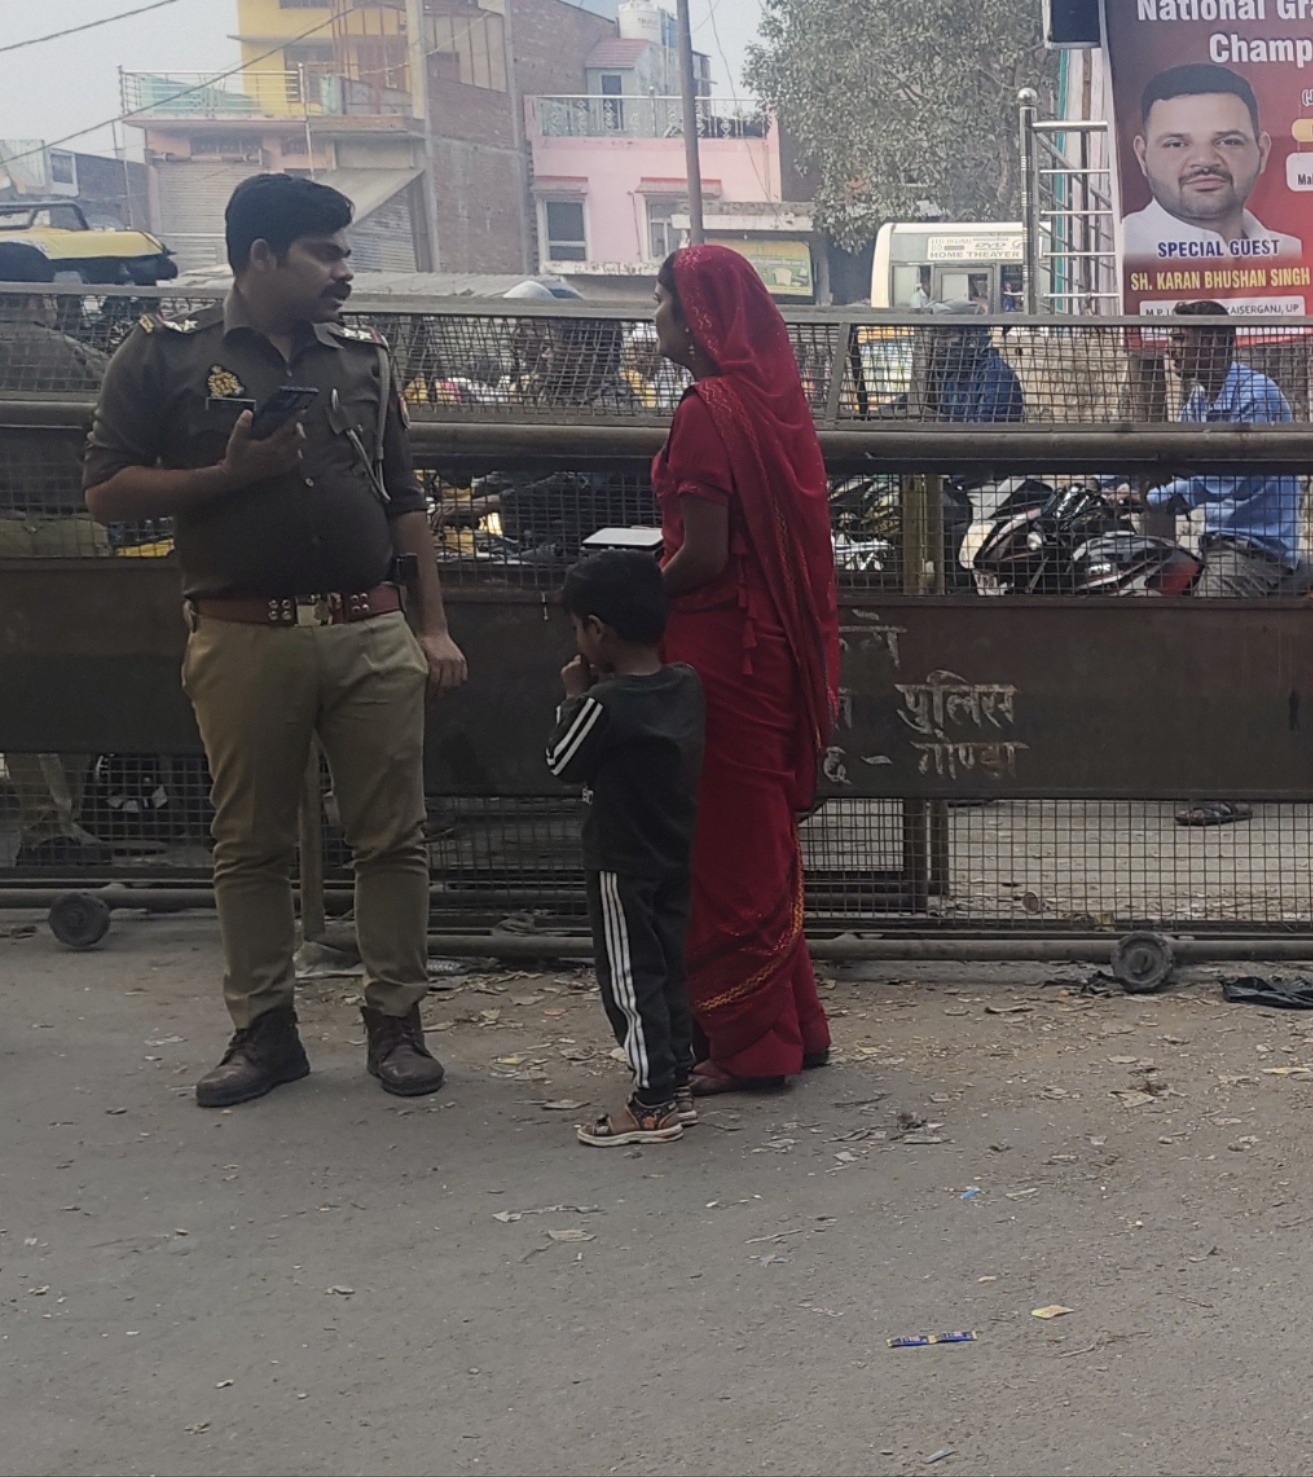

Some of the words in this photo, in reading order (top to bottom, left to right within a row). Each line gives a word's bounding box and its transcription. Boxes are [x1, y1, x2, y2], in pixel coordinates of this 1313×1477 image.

[1138, 0, 1266, 21] National
[1157, 241, 1224, 258] SPECIAL
[1229, 239, 1280, 256] GUEST
[1130, 272, 1153, 290] SH.
[1156, 271, 1201, 290] KARAN
[1204, 268, 1267, 289] BHUSHAN
[1270, 267, 1311, 287] SINGH
[1286, 303, 1300, 313] UP
